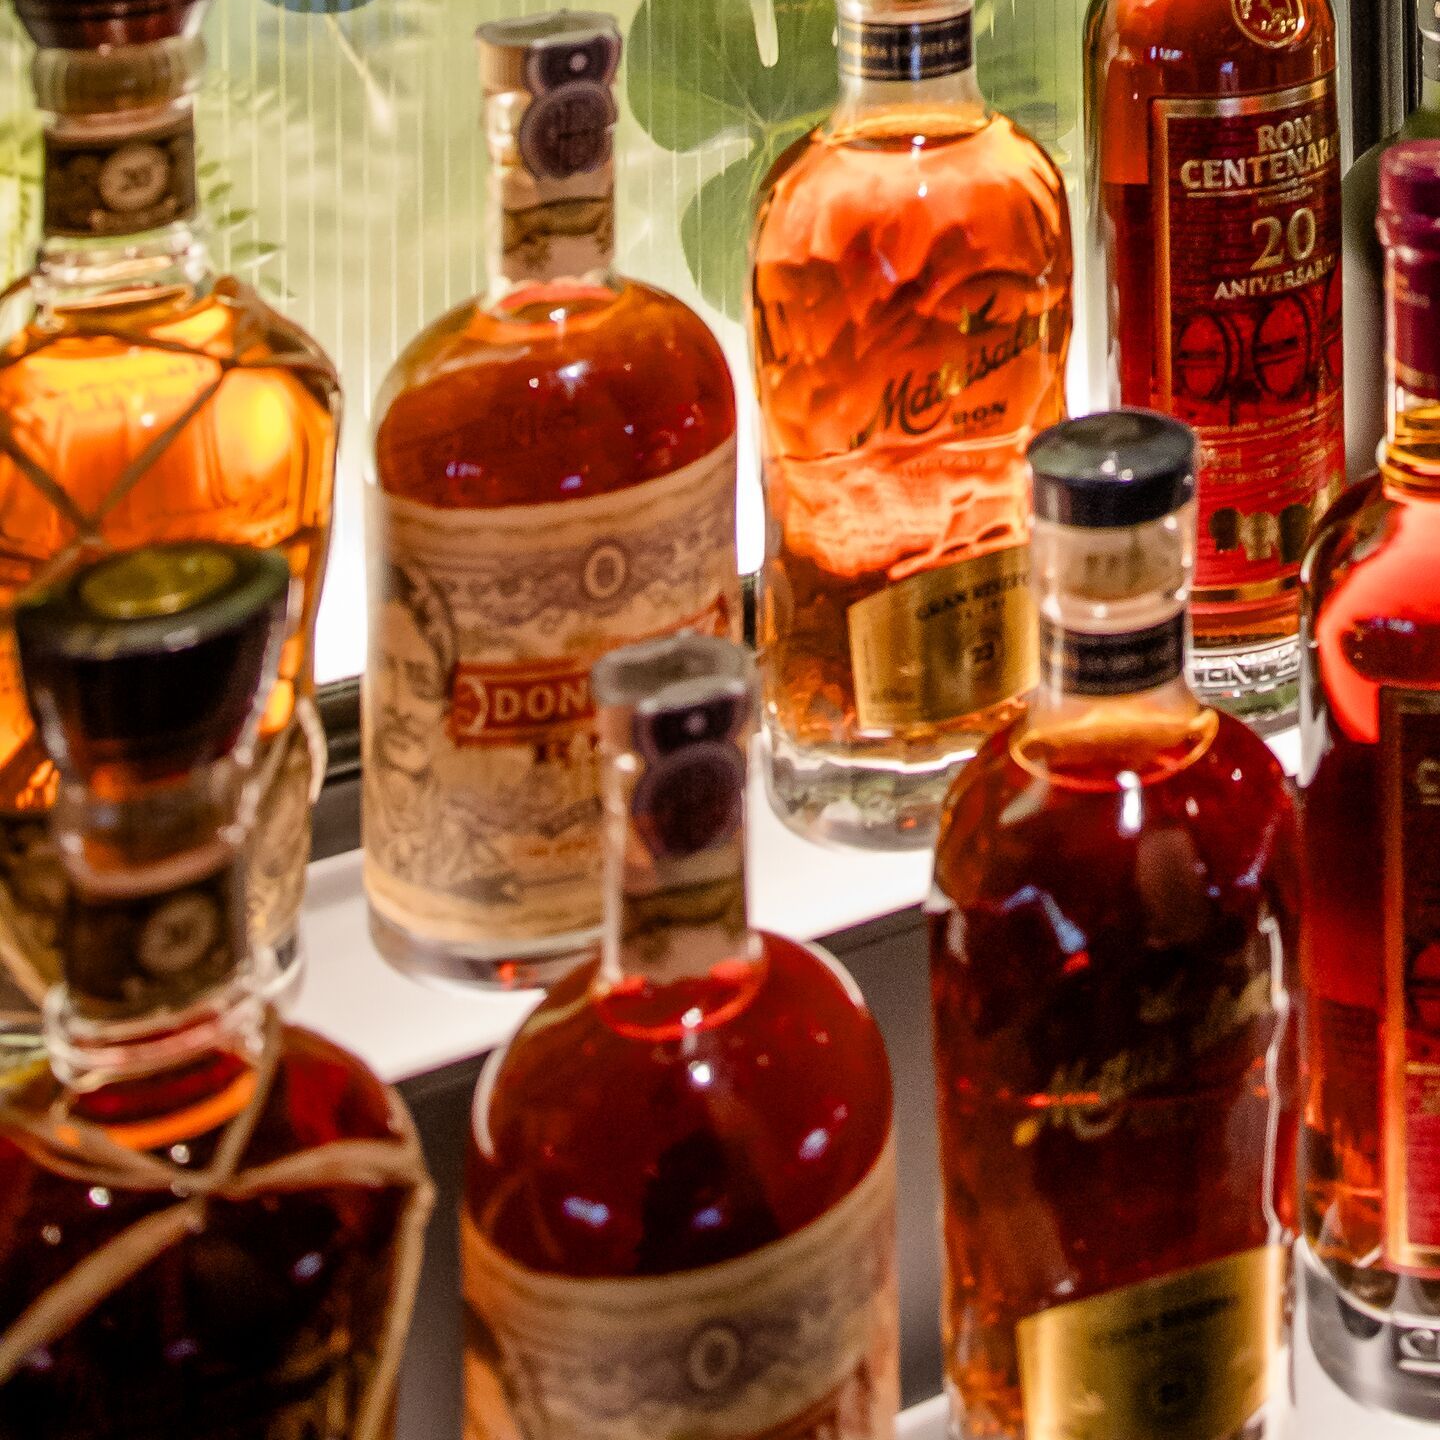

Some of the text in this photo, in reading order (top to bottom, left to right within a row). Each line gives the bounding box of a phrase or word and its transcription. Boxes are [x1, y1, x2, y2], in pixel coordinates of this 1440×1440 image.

[1256, 114, 1313, 153] RON
[1249, 207, 1317, 271] 20
[493, 680, 590, 722] DON
